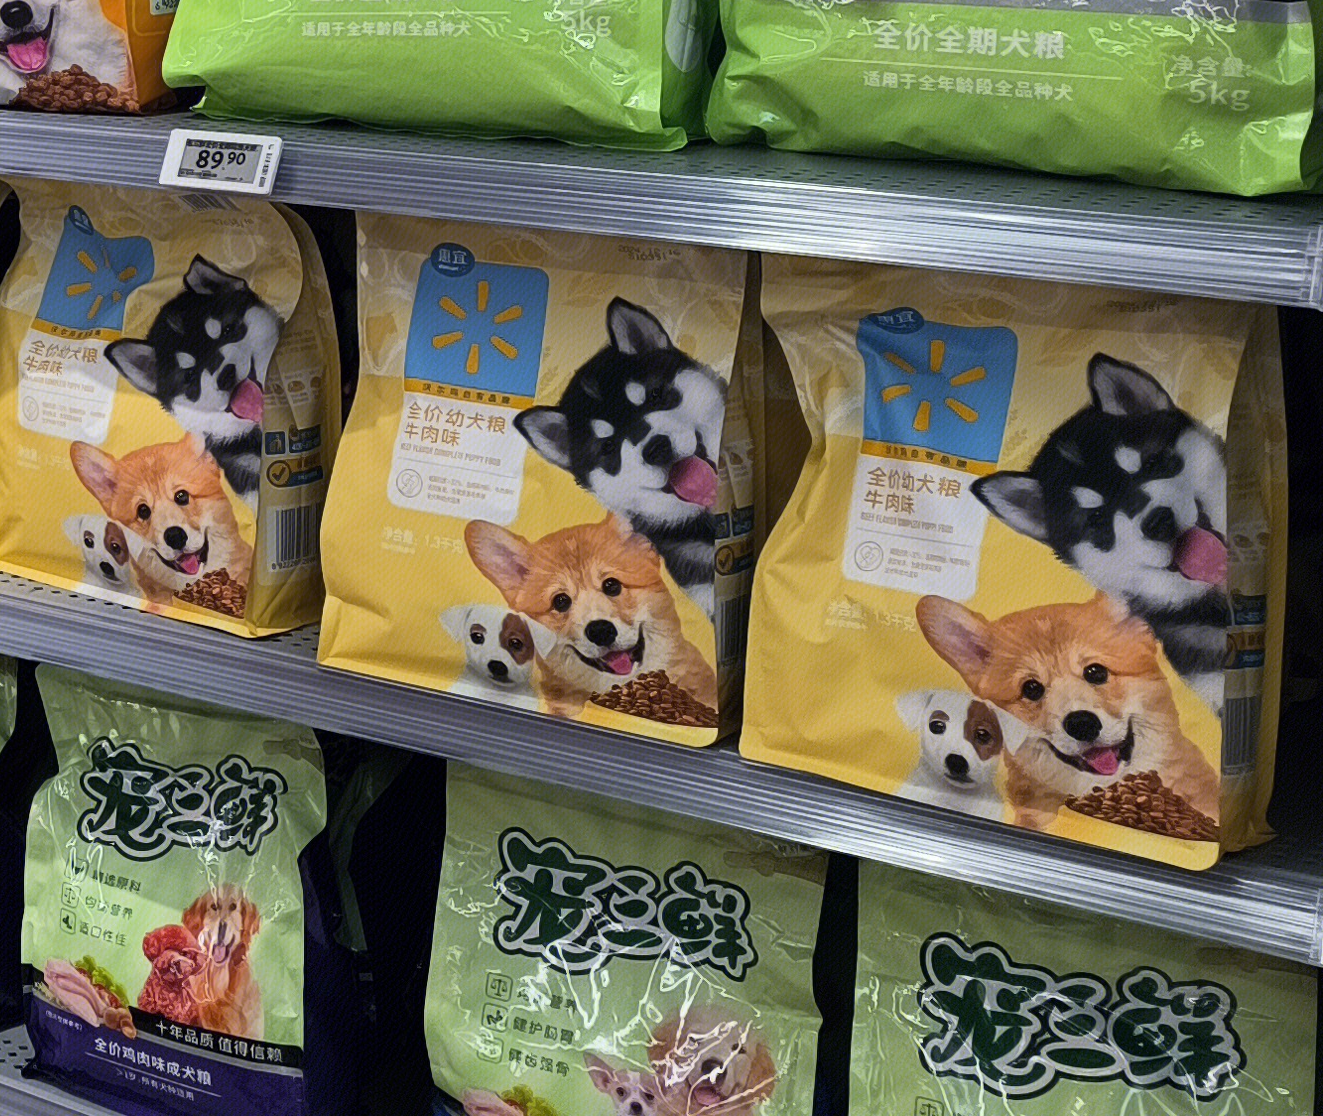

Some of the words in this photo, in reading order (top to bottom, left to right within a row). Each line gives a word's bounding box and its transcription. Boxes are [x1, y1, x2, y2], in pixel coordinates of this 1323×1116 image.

[300, 19, 471, 39] 适用于全年龄段全品种犬
[561, 11, 613, 39] 5kg
[873, 22, 1066, 60] 全价全期犬粮
[862, 70, 1075, 103] 适用于全年龄段全品种犬
[1187, 79, 1251, 112] 5kg
[22, 356, 63, 376] 牛肉味
[28, 339, 98, 364] 全价幼犬粮
[406, 401, 507, 434] 全价幼犬粮
[404, 424, 461, 446] 牛肉味
[866, 466, 962, 499] 全价幼犬粮
[863, 490, 916, 515] 牛肉味
[79, 921, 127, 947] 适口性佳
[155, 1019, 215, 1050] 十年品质
[218, 1035, 283, 1064] 值得信赖
[94, 1037, 212, 1087] 全价鸡肉味成犬粮
